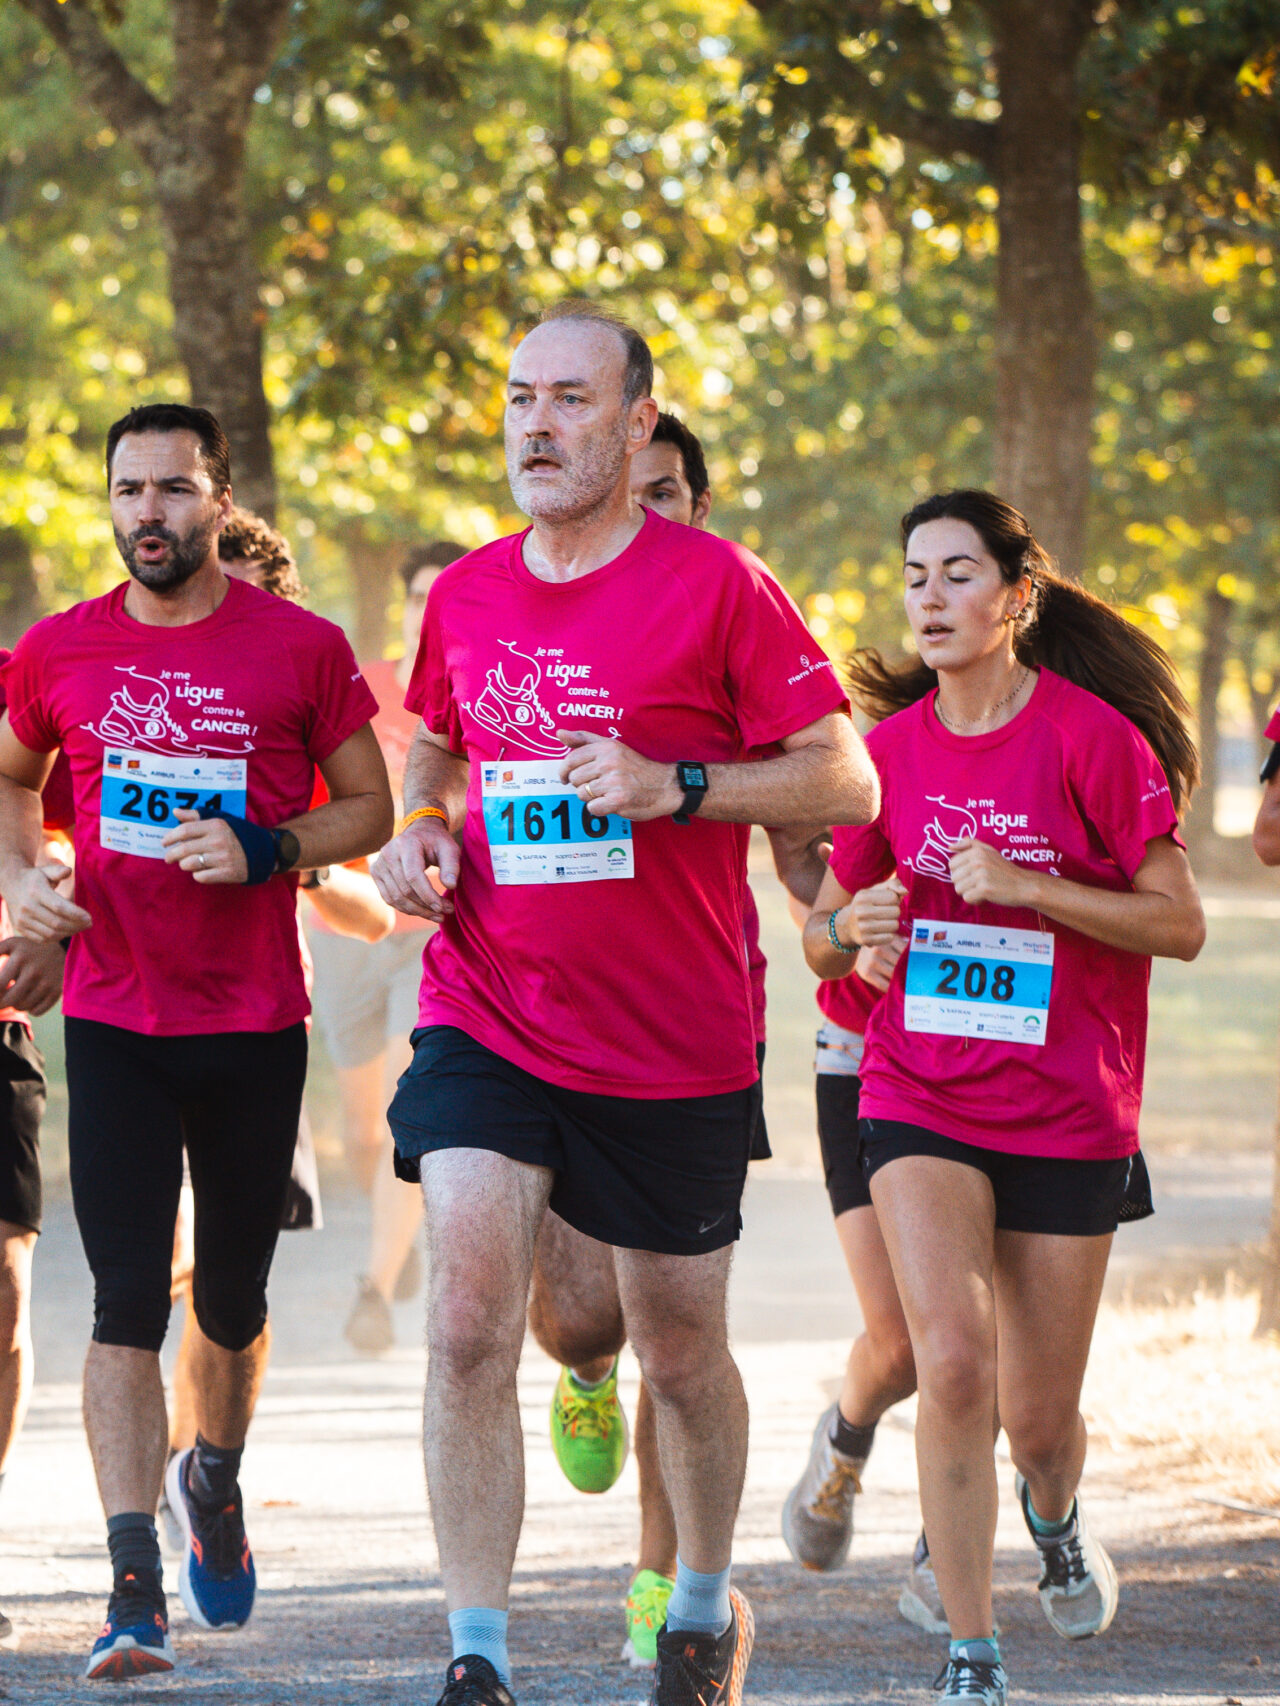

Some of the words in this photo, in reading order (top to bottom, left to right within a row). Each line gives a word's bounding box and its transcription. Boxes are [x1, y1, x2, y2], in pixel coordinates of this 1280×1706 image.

[534, 646, 546, 657] Je
[547, 648, 564, 657] me
[159, 670, 172, 680] Je
[172, 671, 191, 681] me
[567, 686, 599, 697] contre
[599, 688, 610, 698] le
[202, 706, 235, 717] contre
[235, 707, 246, 718] le
[556, 702, 616, 720] CANCER
[617, 707, 625, 721] !
[191, 718, 250, 736] CANCER
[251, 725, 258, 737] !
[965, 797, 977, 809] Je
[978, 799, 995, 808] me
[501, 799, 609, 841] 1616
[1008, 834, 1039, 845] contre
[1039, 835, 1049, 845] le
[1001, 848, 1055, 863] CANCER
[934, 958, 1017, 1002] 208
